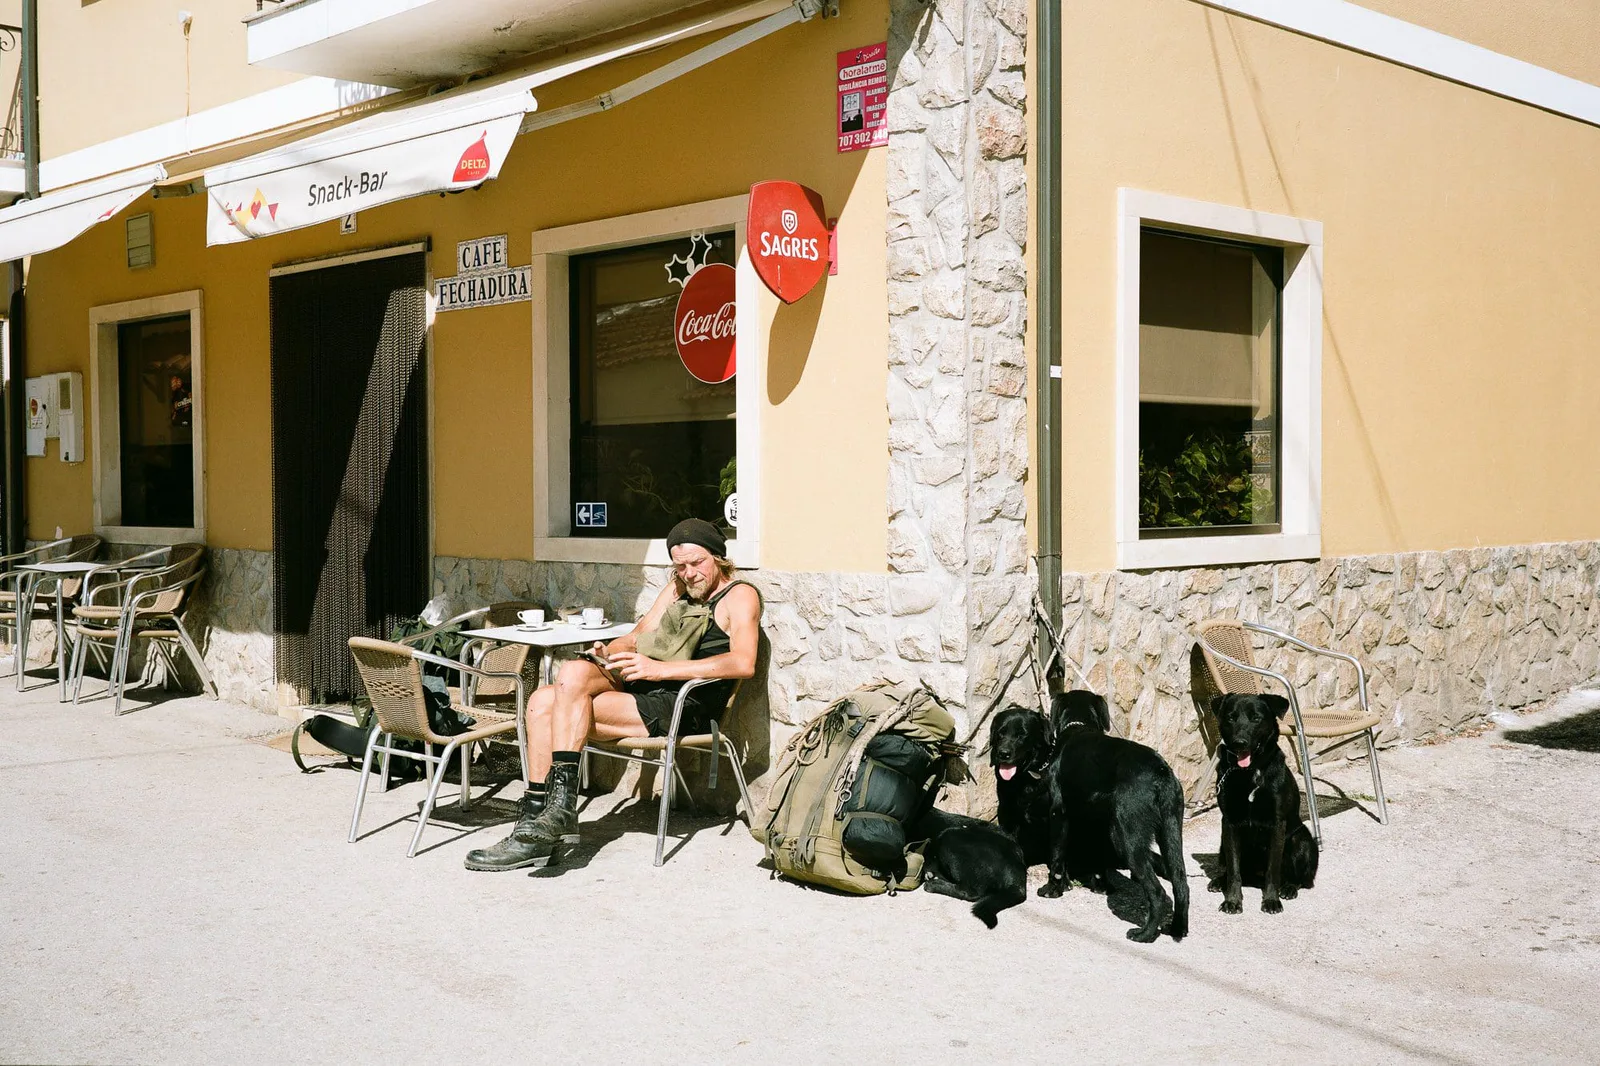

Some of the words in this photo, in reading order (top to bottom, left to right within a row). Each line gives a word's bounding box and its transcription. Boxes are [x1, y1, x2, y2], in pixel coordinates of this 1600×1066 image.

[843, 62, 886, 79] horalarme
[839, 134, 854, 147] 707
[854, 131, 871, 144] 302
[461, 158, 487, 170] DELTA
[307, 168, 388, 208] Snack-Bar
[344, 213, 352, 229] 2
[462, 241, 502, 269] CAFE
[760, 231, 819, 262] SAGRES
[439, 272, 529, 306] FECHADURA
[678, 301, 737, 346] Coca-Col
